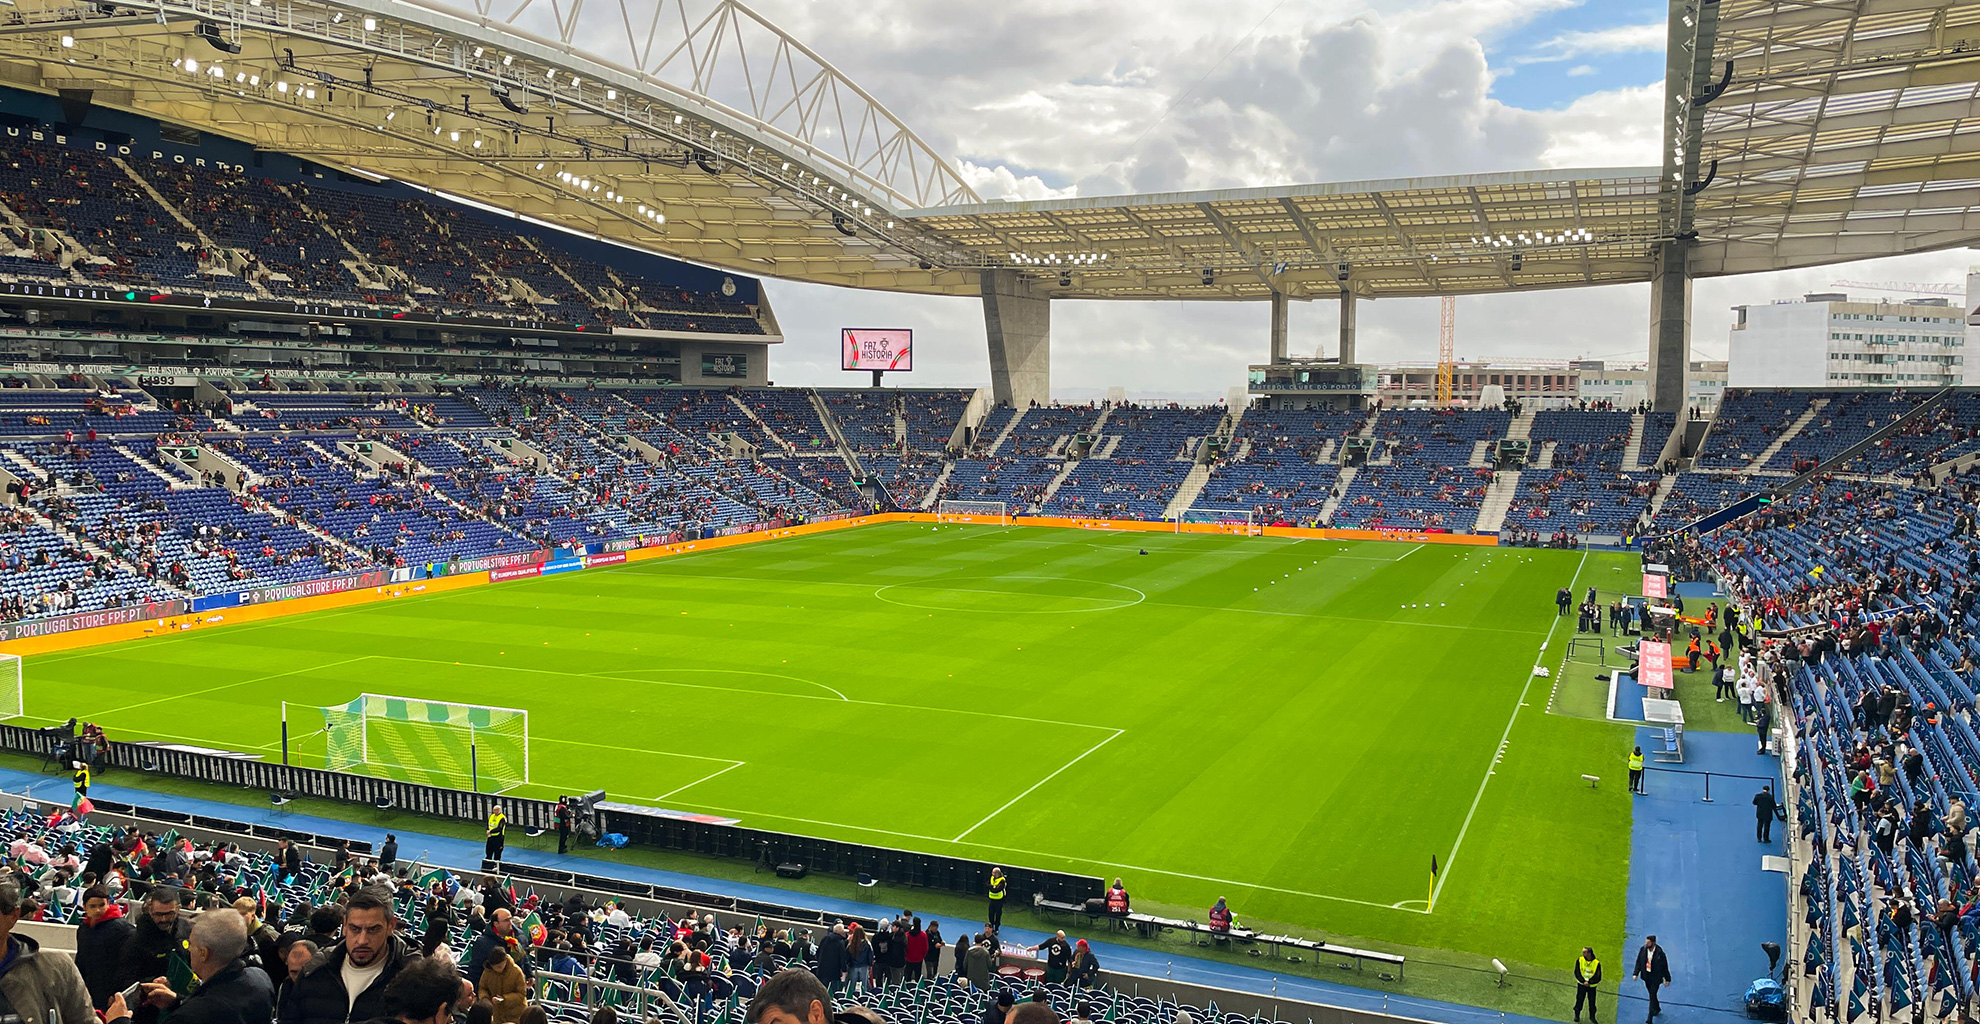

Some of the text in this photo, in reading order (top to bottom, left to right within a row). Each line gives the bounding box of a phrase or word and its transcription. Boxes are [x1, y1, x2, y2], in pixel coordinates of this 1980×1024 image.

[95, 141, 131, 155] DO
[152, 150, 245, 173] PORTO
[9, 284, 110, 300] PORTUGAL
[294, 305, 367, 318] PORTGAL
[864, 341, 877, 350] FAZ
[862, 350, 893, 360] HISTORIA
[459, 553, 530, 572] PORTUGALSTORE.FPF.PT
[497, 569, 518, 579] EUROPEAN
[264, 576, 358, 601] PORTUGALSTORE.FPF.PT
[15, 607, 142, 638] PORTUGALSTORE.FPF.PT
